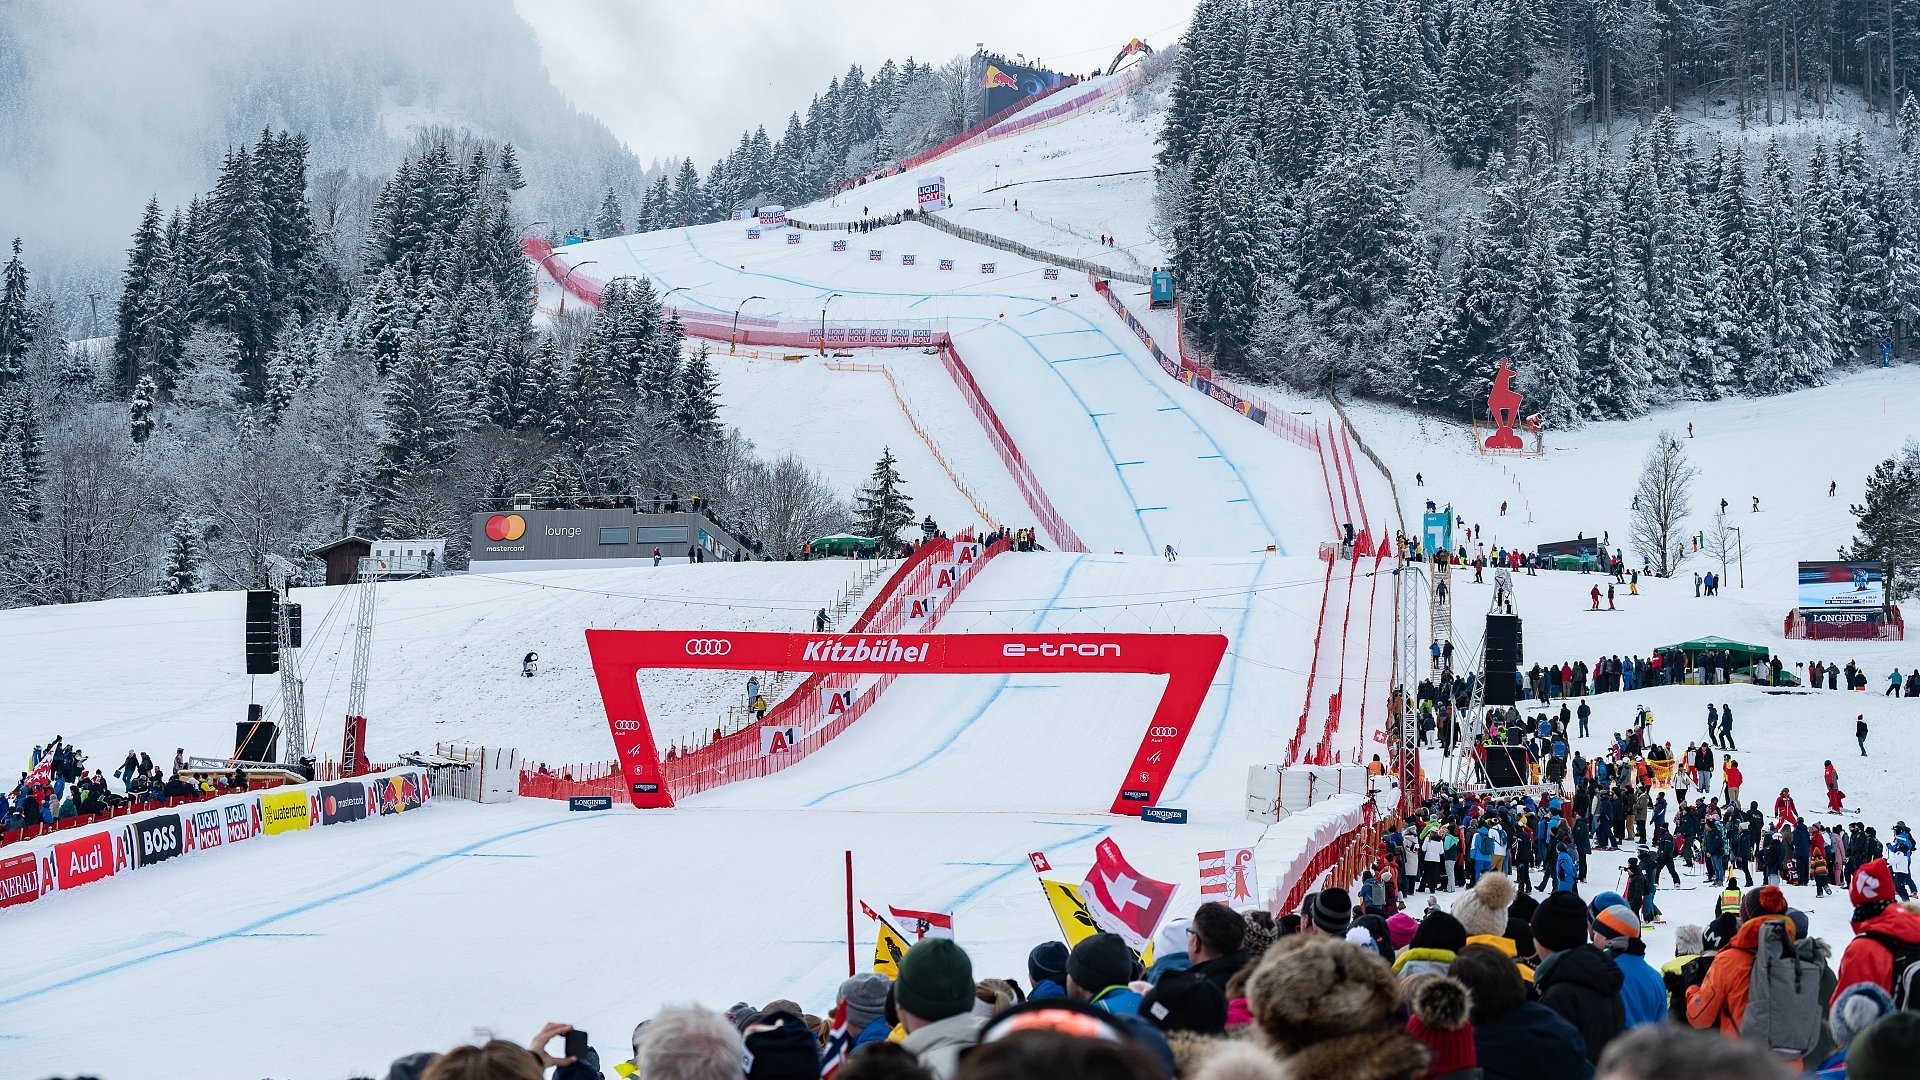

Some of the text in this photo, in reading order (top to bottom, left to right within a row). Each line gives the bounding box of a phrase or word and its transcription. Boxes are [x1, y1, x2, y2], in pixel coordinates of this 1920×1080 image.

[918, 184, 939, 195] LIQUI
[919, 192, 939, 203] MOLY
[545, 524, 582, 538] lounge
[958, 544, 978, 564] A1
[936, 566, 956, 589] A1
[909, 598, 928, 619] A1
[1813, 614, 1868, 622] LONGINES
[802, 638, 930, 663] Kitzbühel
[1002, 642, 1121, 657] e-tron
[828, 690, 851, 714] A1
[769, 727, 794, 754] A1
[310, 789, 322, 826] A1
[338, 795, 364, 809] mastercard
[197, 810, 219, 829] LIQUI
[225, 804, 247, 824] LIQUI
[273, 805, 307, 821] waterdrop
[1146, 809, 1182, 818] LONGINES
[142, 824, 177, 856] BOSS
[184, 813, 198, 854] A1
[199, 829, 222, 850] MOLY
[227, 822, 250, 843] MOLY
[69, 843, 103, 877] Audi
[115, 829, 130, 873] A1
[41, 850, 57, 896] A1
